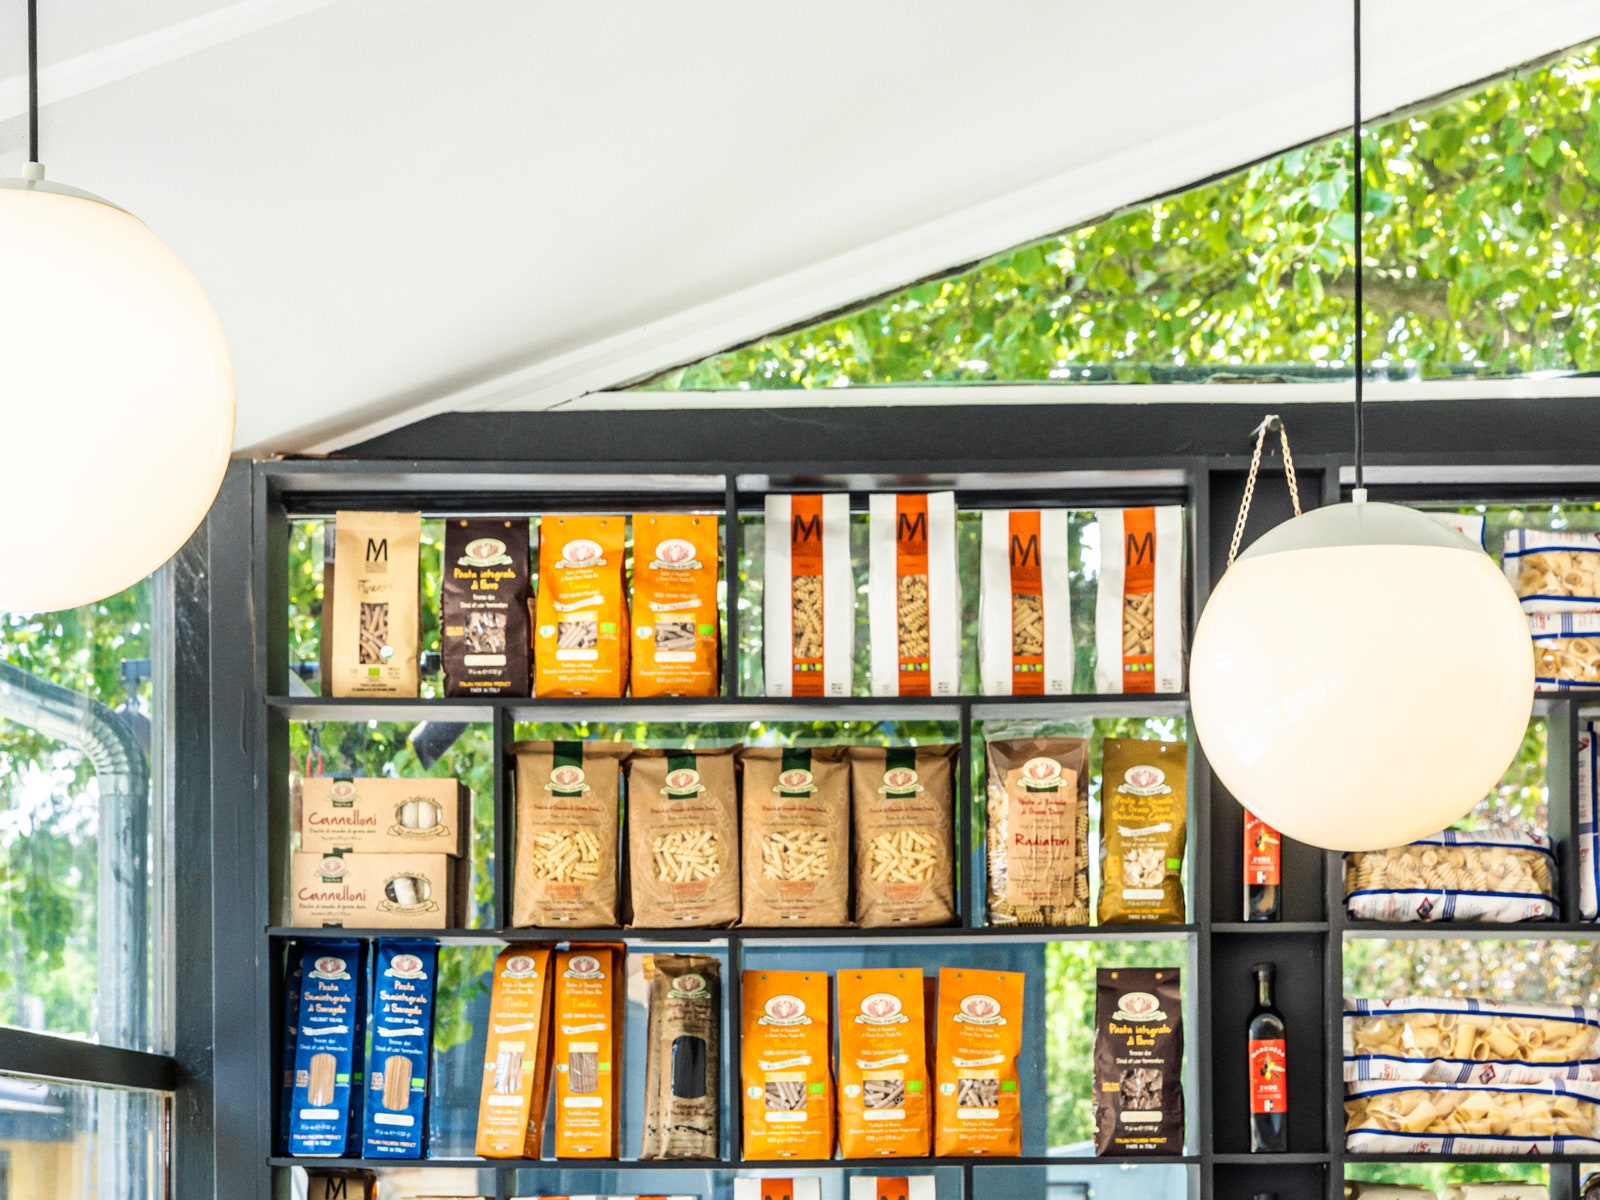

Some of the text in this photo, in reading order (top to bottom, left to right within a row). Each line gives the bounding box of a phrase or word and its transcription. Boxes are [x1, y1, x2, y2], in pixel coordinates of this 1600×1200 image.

[793, 514, 821, 541] M
[898, 512, 927, 541] M
[366, 538, 388, 562] M
[1011, 534, 1040, 566] M
[1127, 532, 1154, 566] M
[308, 810, 377, 826] Cannelloni
[1015, 832, 1070, 846] Radiatori
[298, 885, 366, 901] Cannelloni
[325, 1177, 347, 1200] M
